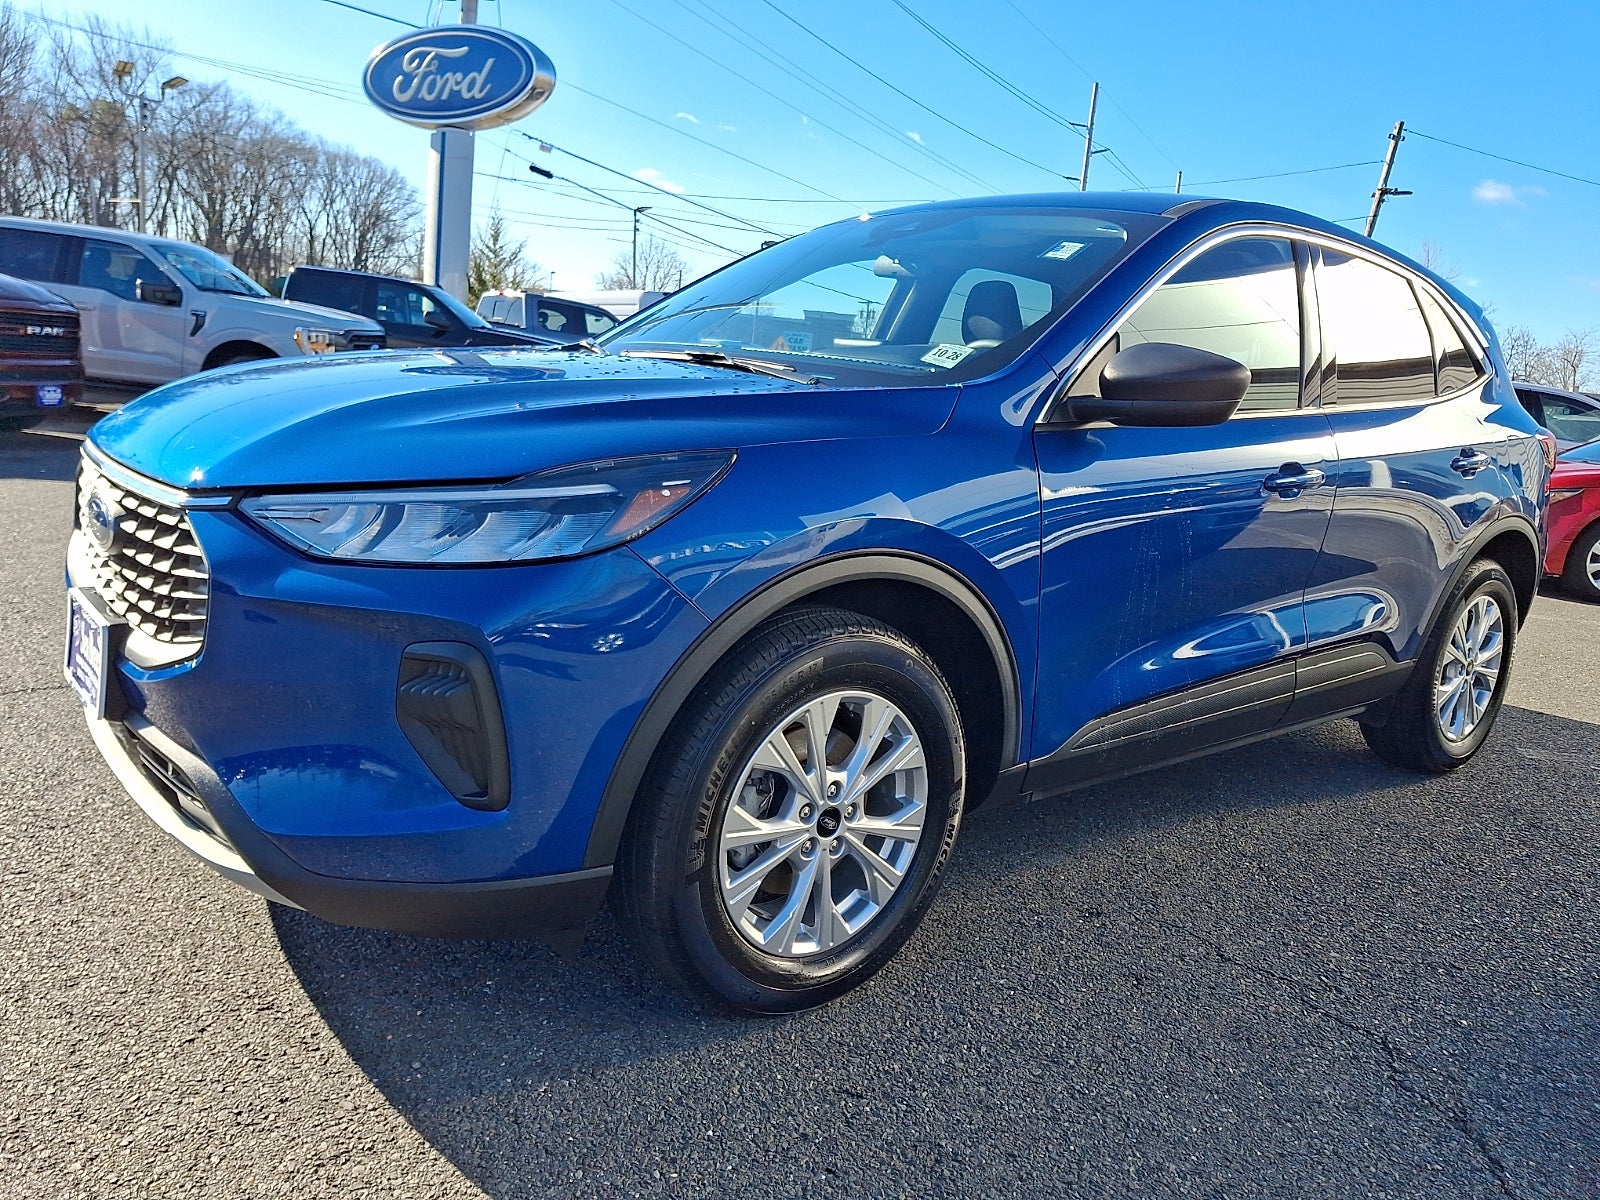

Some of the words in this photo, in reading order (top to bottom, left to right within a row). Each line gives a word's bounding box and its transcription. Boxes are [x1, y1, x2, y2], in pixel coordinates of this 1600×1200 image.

[392, 46, 496, 102] Ford
[932, 349, 948, 357] 10
[946, 352, 962, 360] 28
